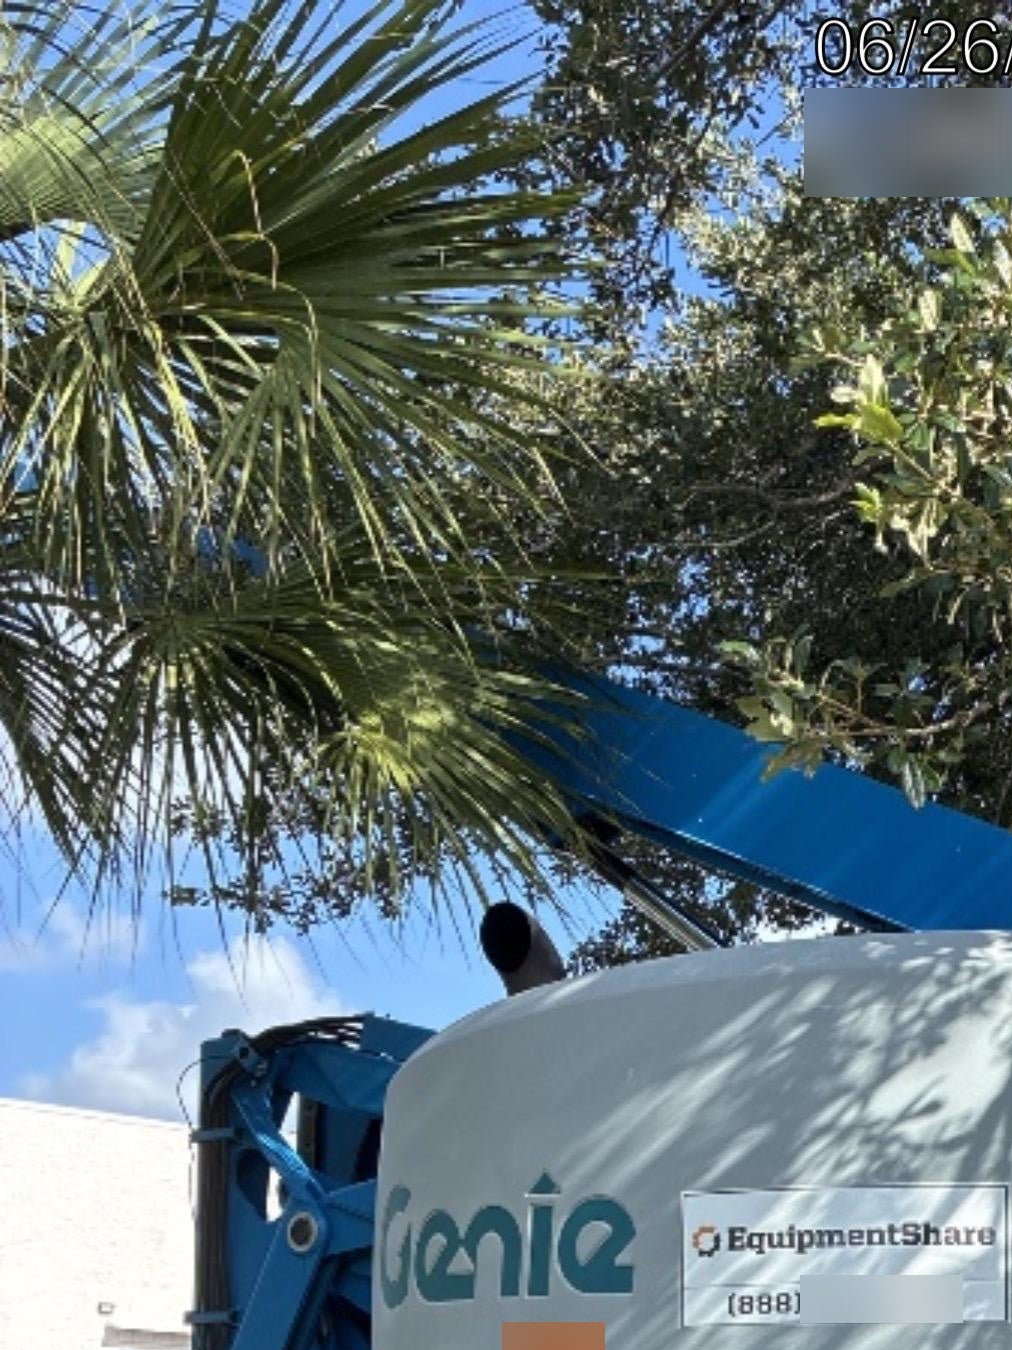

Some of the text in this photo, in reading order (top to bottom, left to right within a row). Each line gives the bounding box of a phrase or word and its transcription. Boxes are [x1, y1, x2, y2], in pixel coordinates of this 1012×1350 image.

[381, 1172, 637, 1310] Genie
[727, 1222, 997, 1254] EquipmentShare
[727, 1292, 801, 1318] (888)
